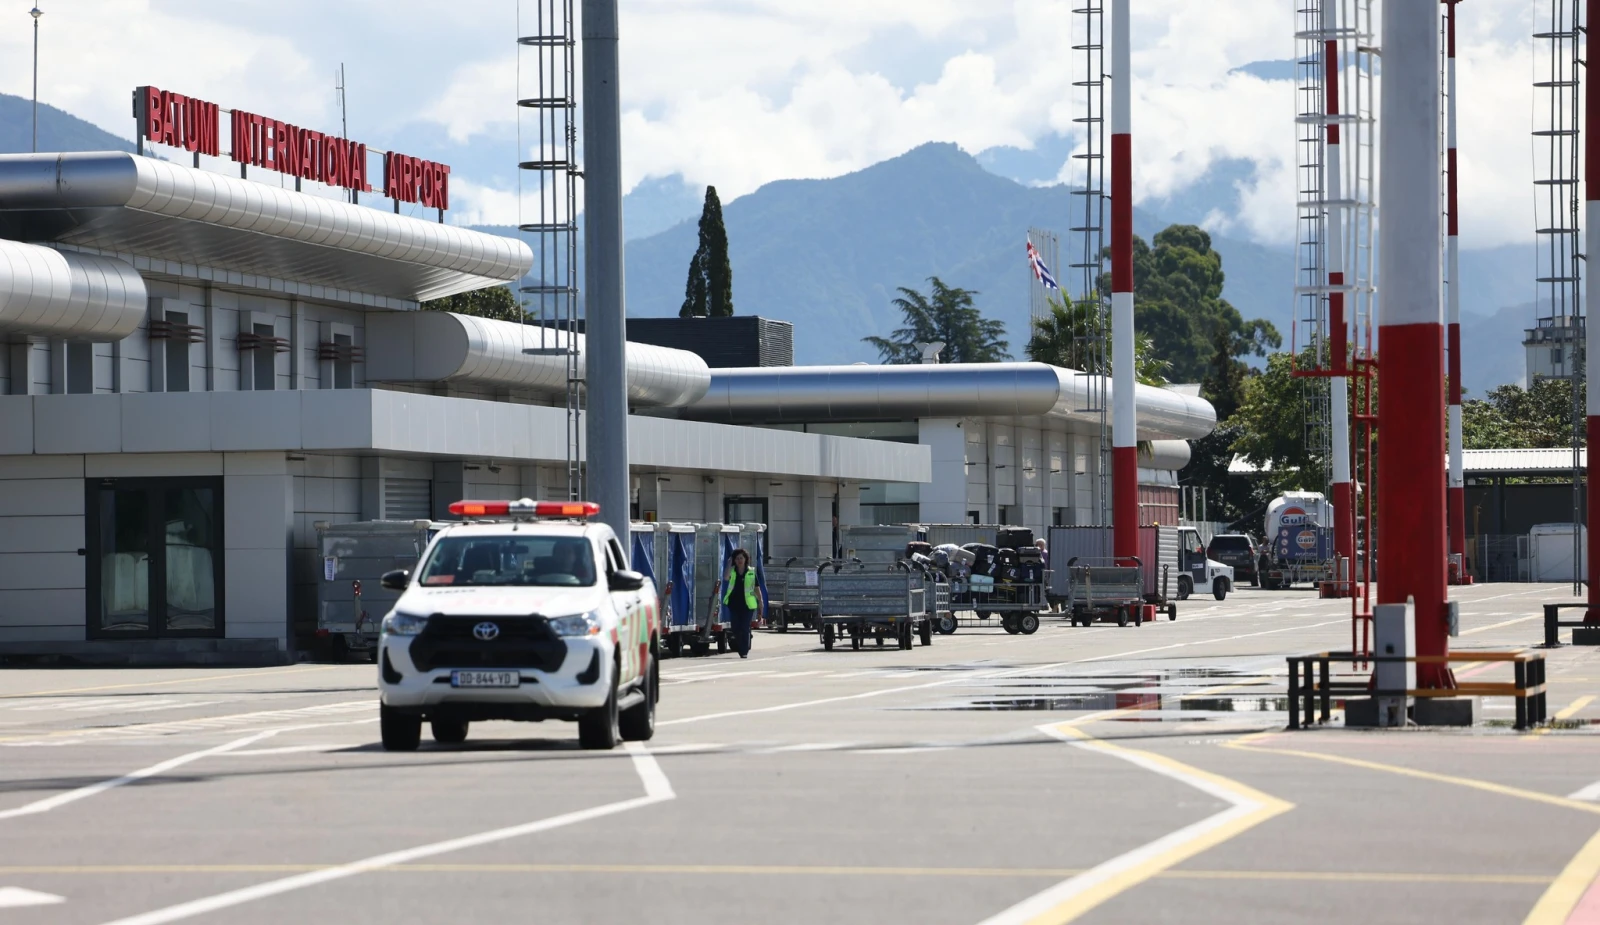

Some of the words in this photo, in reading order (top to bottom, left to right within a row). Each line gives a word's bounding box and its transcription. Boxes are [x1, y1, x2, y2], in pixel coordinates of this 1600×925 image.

[144, 85, 219, 157] BATUMI
[231, 109, 372, 193] INTERNATIONAL
[385, 151, 450, 210] AIRPORT
[1281, 515, 1309, 524] Gulf
[460, 672, 511, 684] DD-844-YD
